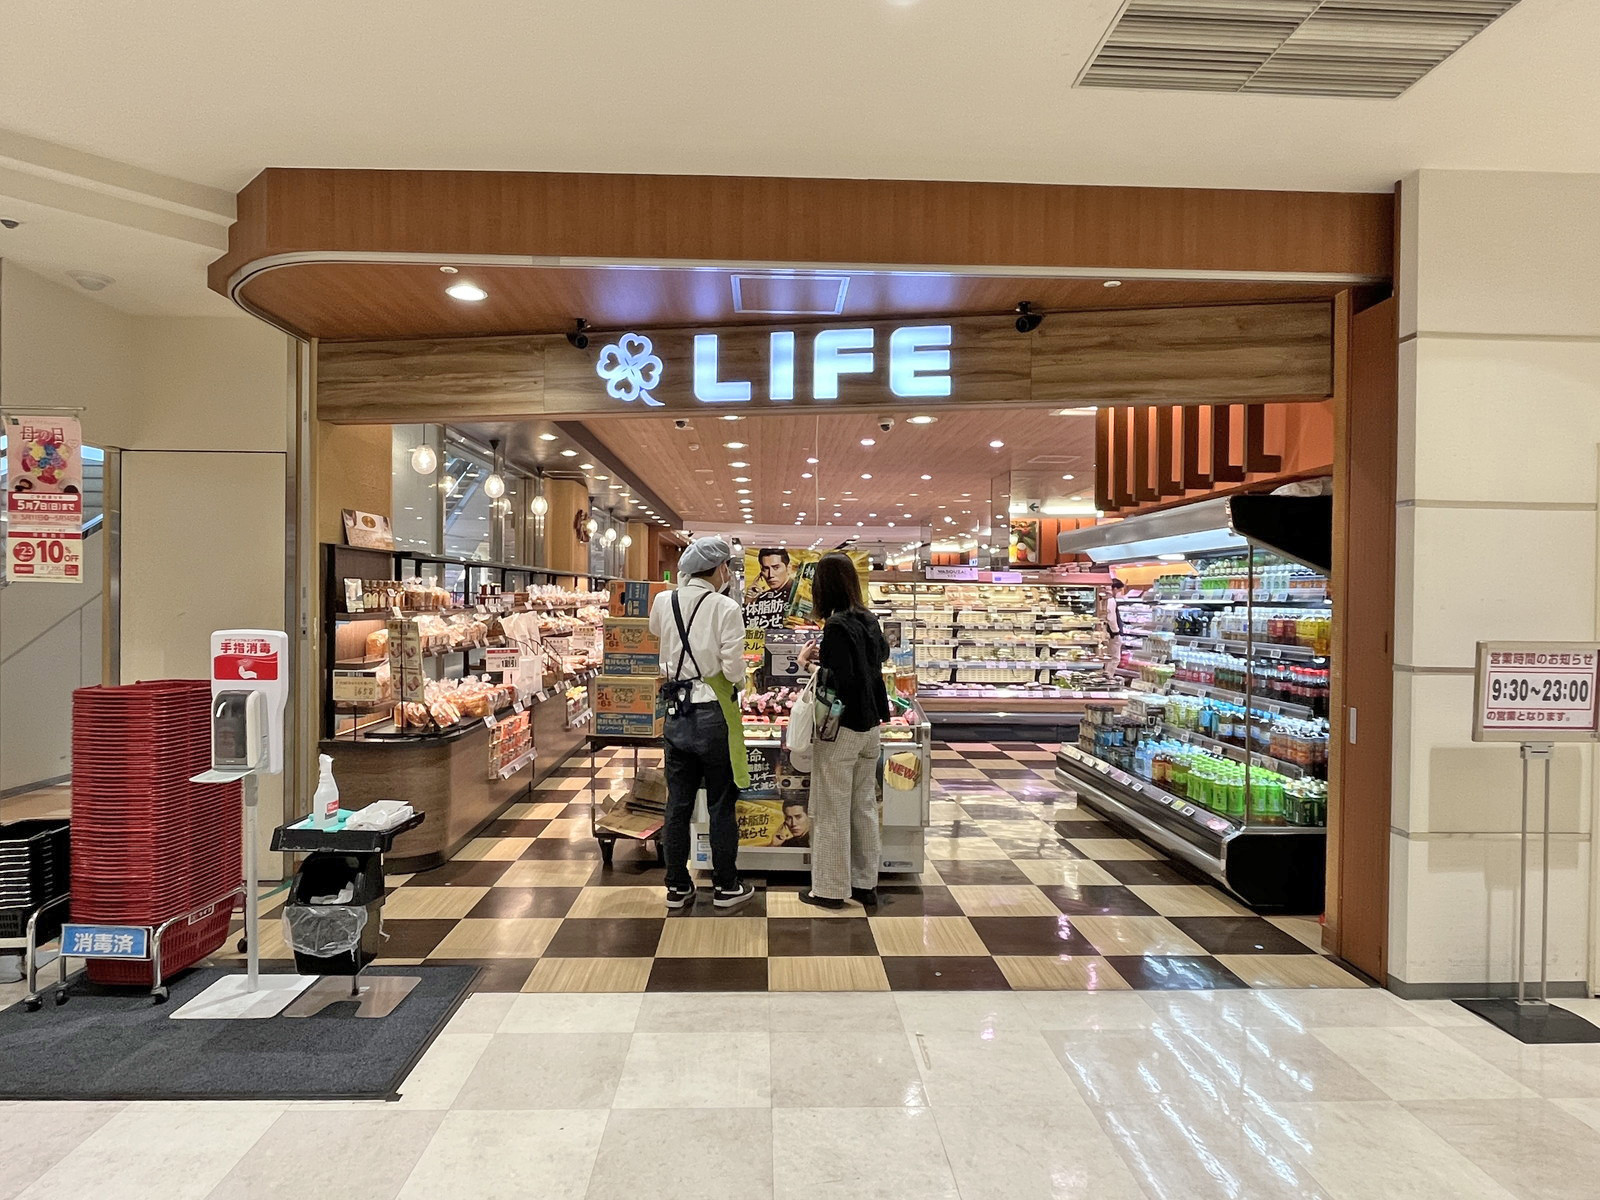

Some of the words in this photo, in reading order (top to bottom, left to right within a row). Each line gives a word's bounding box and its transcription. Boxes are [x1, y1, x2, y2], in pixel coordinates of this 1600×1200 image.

[694, 325, 951, 402] LIFE
[20, 426, 64, 443] 母の日
[64, 554, 79, 562] OFF
[745, 614, 784, 629] 減らせ。
[220, 642, 271, 654] 手指消毒
[1490, 652, 1594, 666] 営業時間のお知らせ
[1486, 711, 1570, 722] の営業となります。
[73, 932, 134, 954] 消毒済
